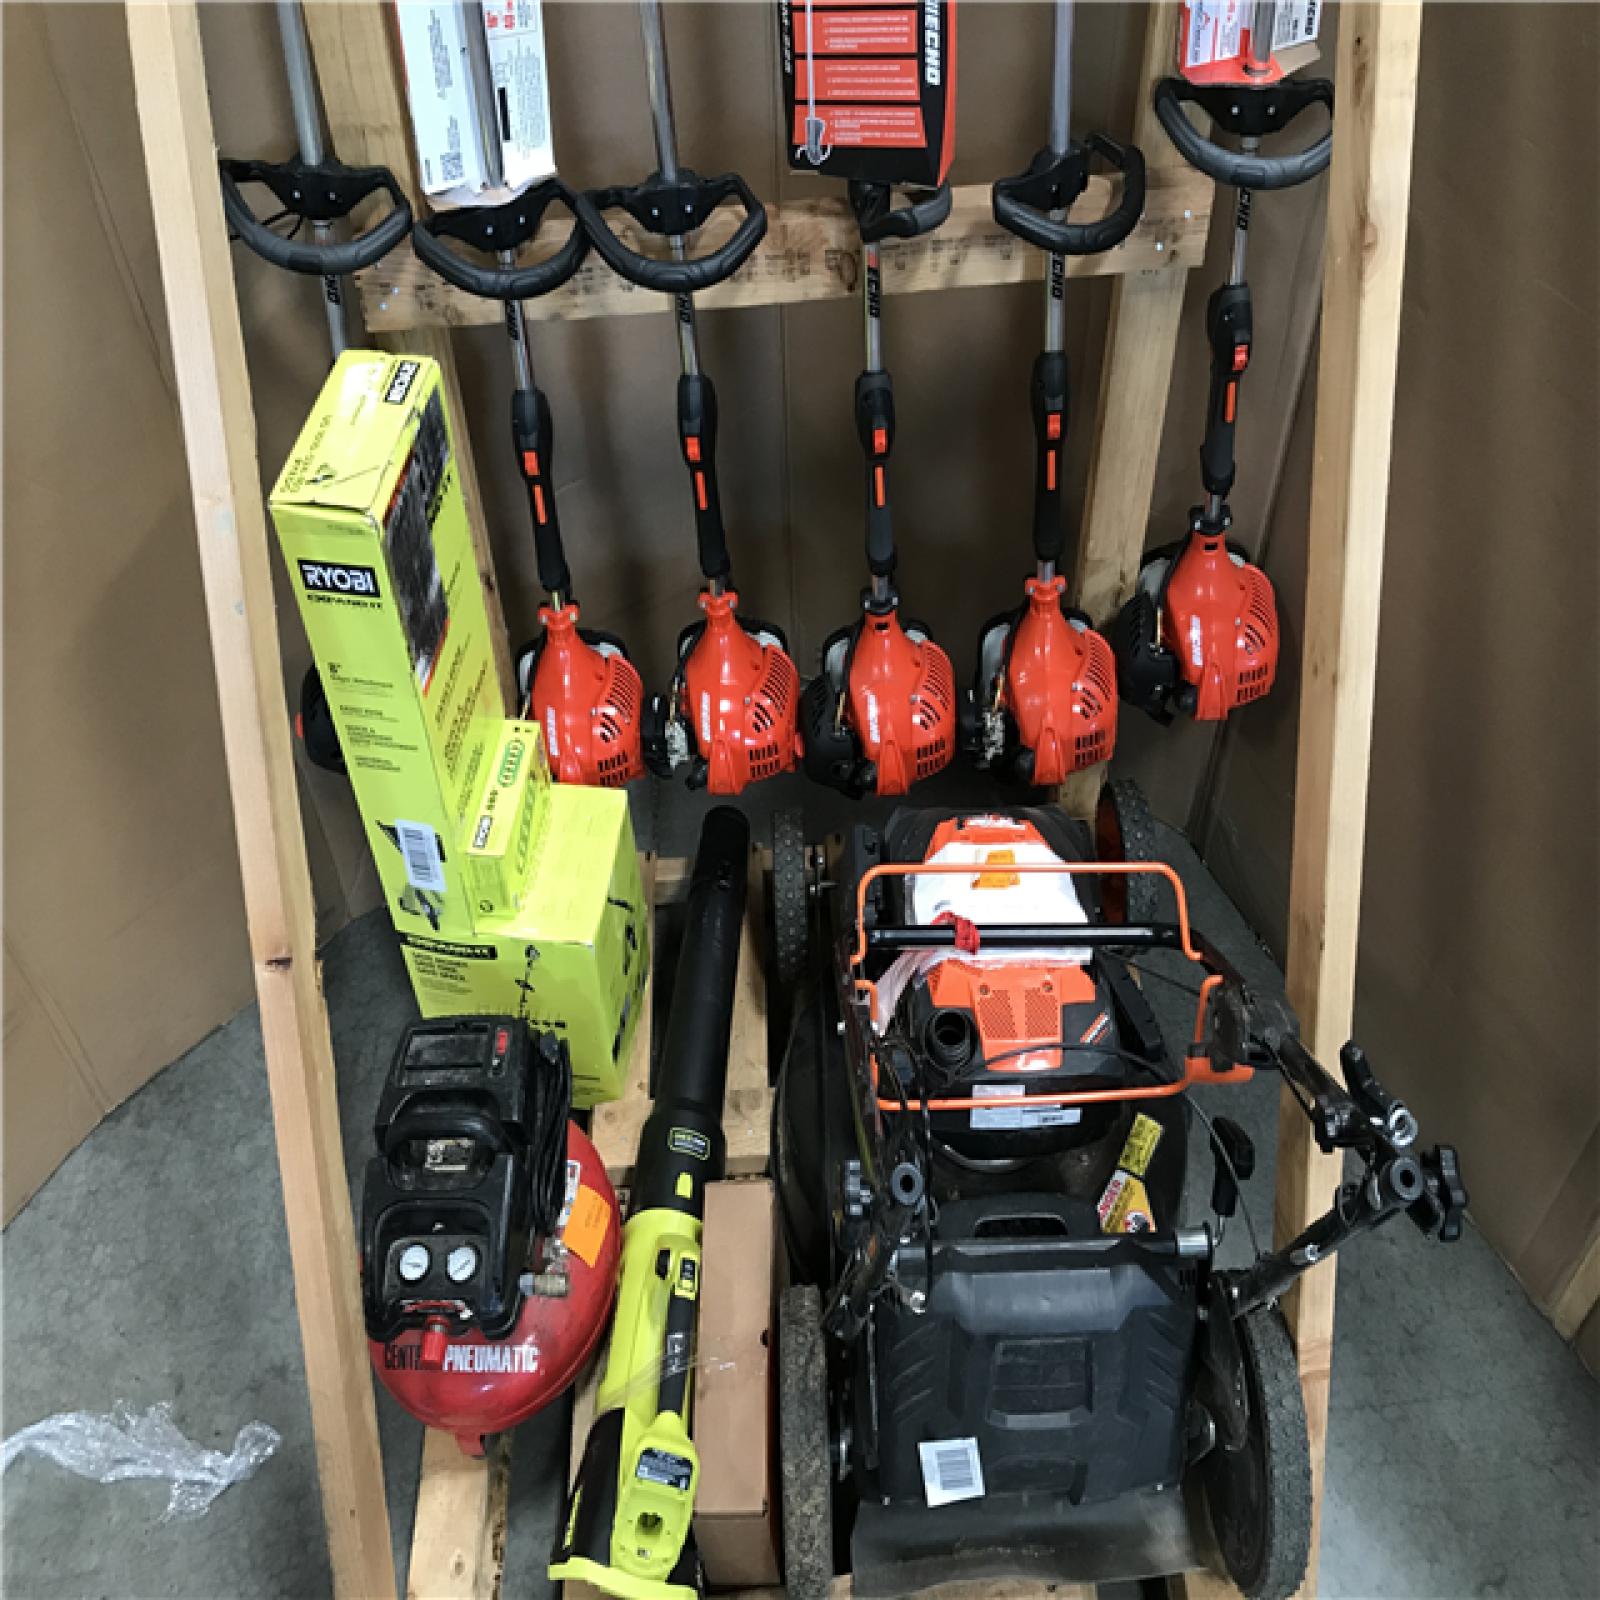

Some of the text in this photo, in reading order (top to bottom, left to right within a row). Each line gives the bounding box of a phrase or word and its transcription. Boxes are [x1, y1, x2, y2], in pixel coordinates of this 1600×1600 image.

[1051, 252, 1064, 300] CHO
[301, 564, 377, 594] RYOBI
[443, 1343, 540, 1371] PNEUMATIC
